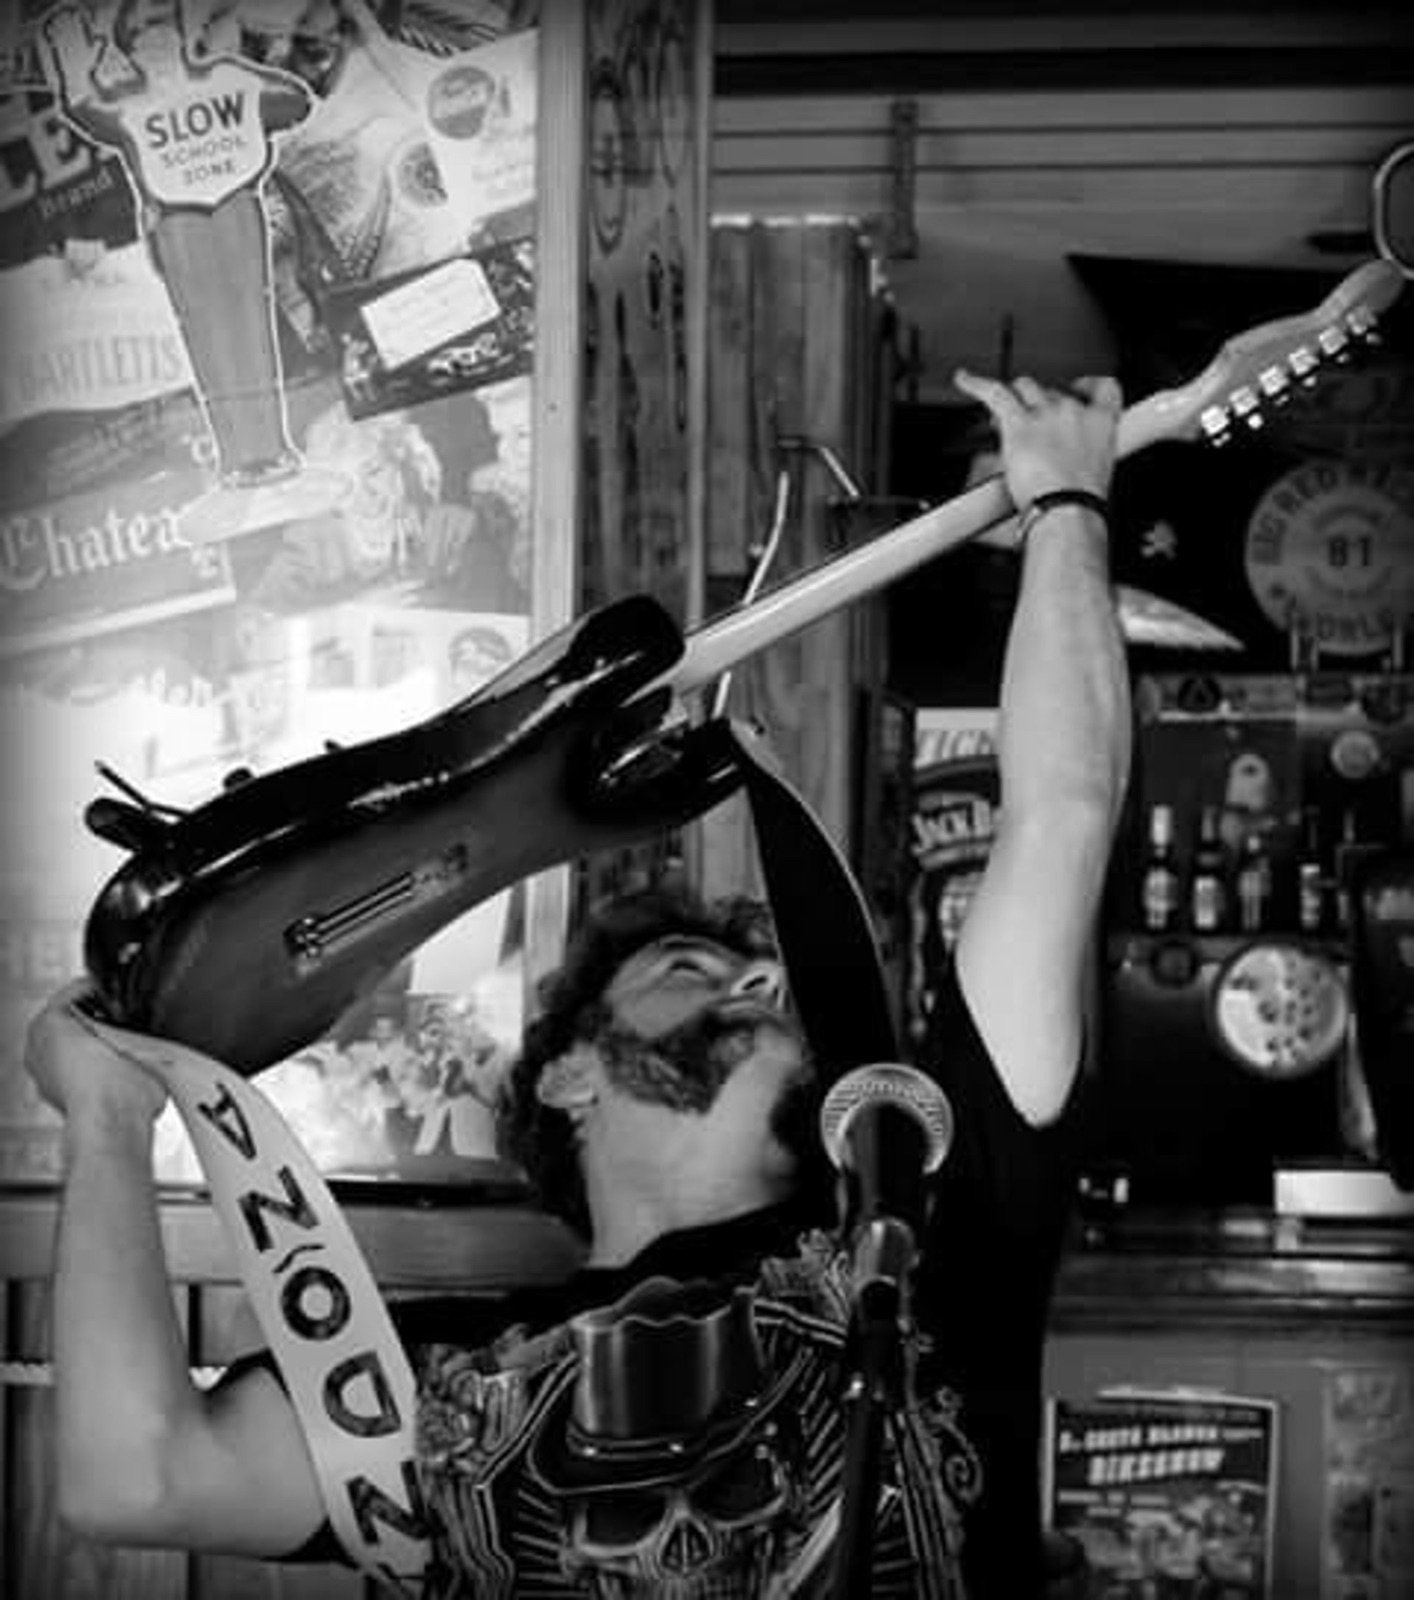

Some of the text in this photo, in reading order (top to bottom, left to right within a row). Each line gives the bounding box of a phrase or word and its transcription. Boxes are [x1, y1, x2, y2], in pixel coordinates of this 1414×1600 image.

[146, 90, 245, 149] SLOW
[163, 132, 248, 170] SCHOOL
[184, 159, 236, 187] ZONE
